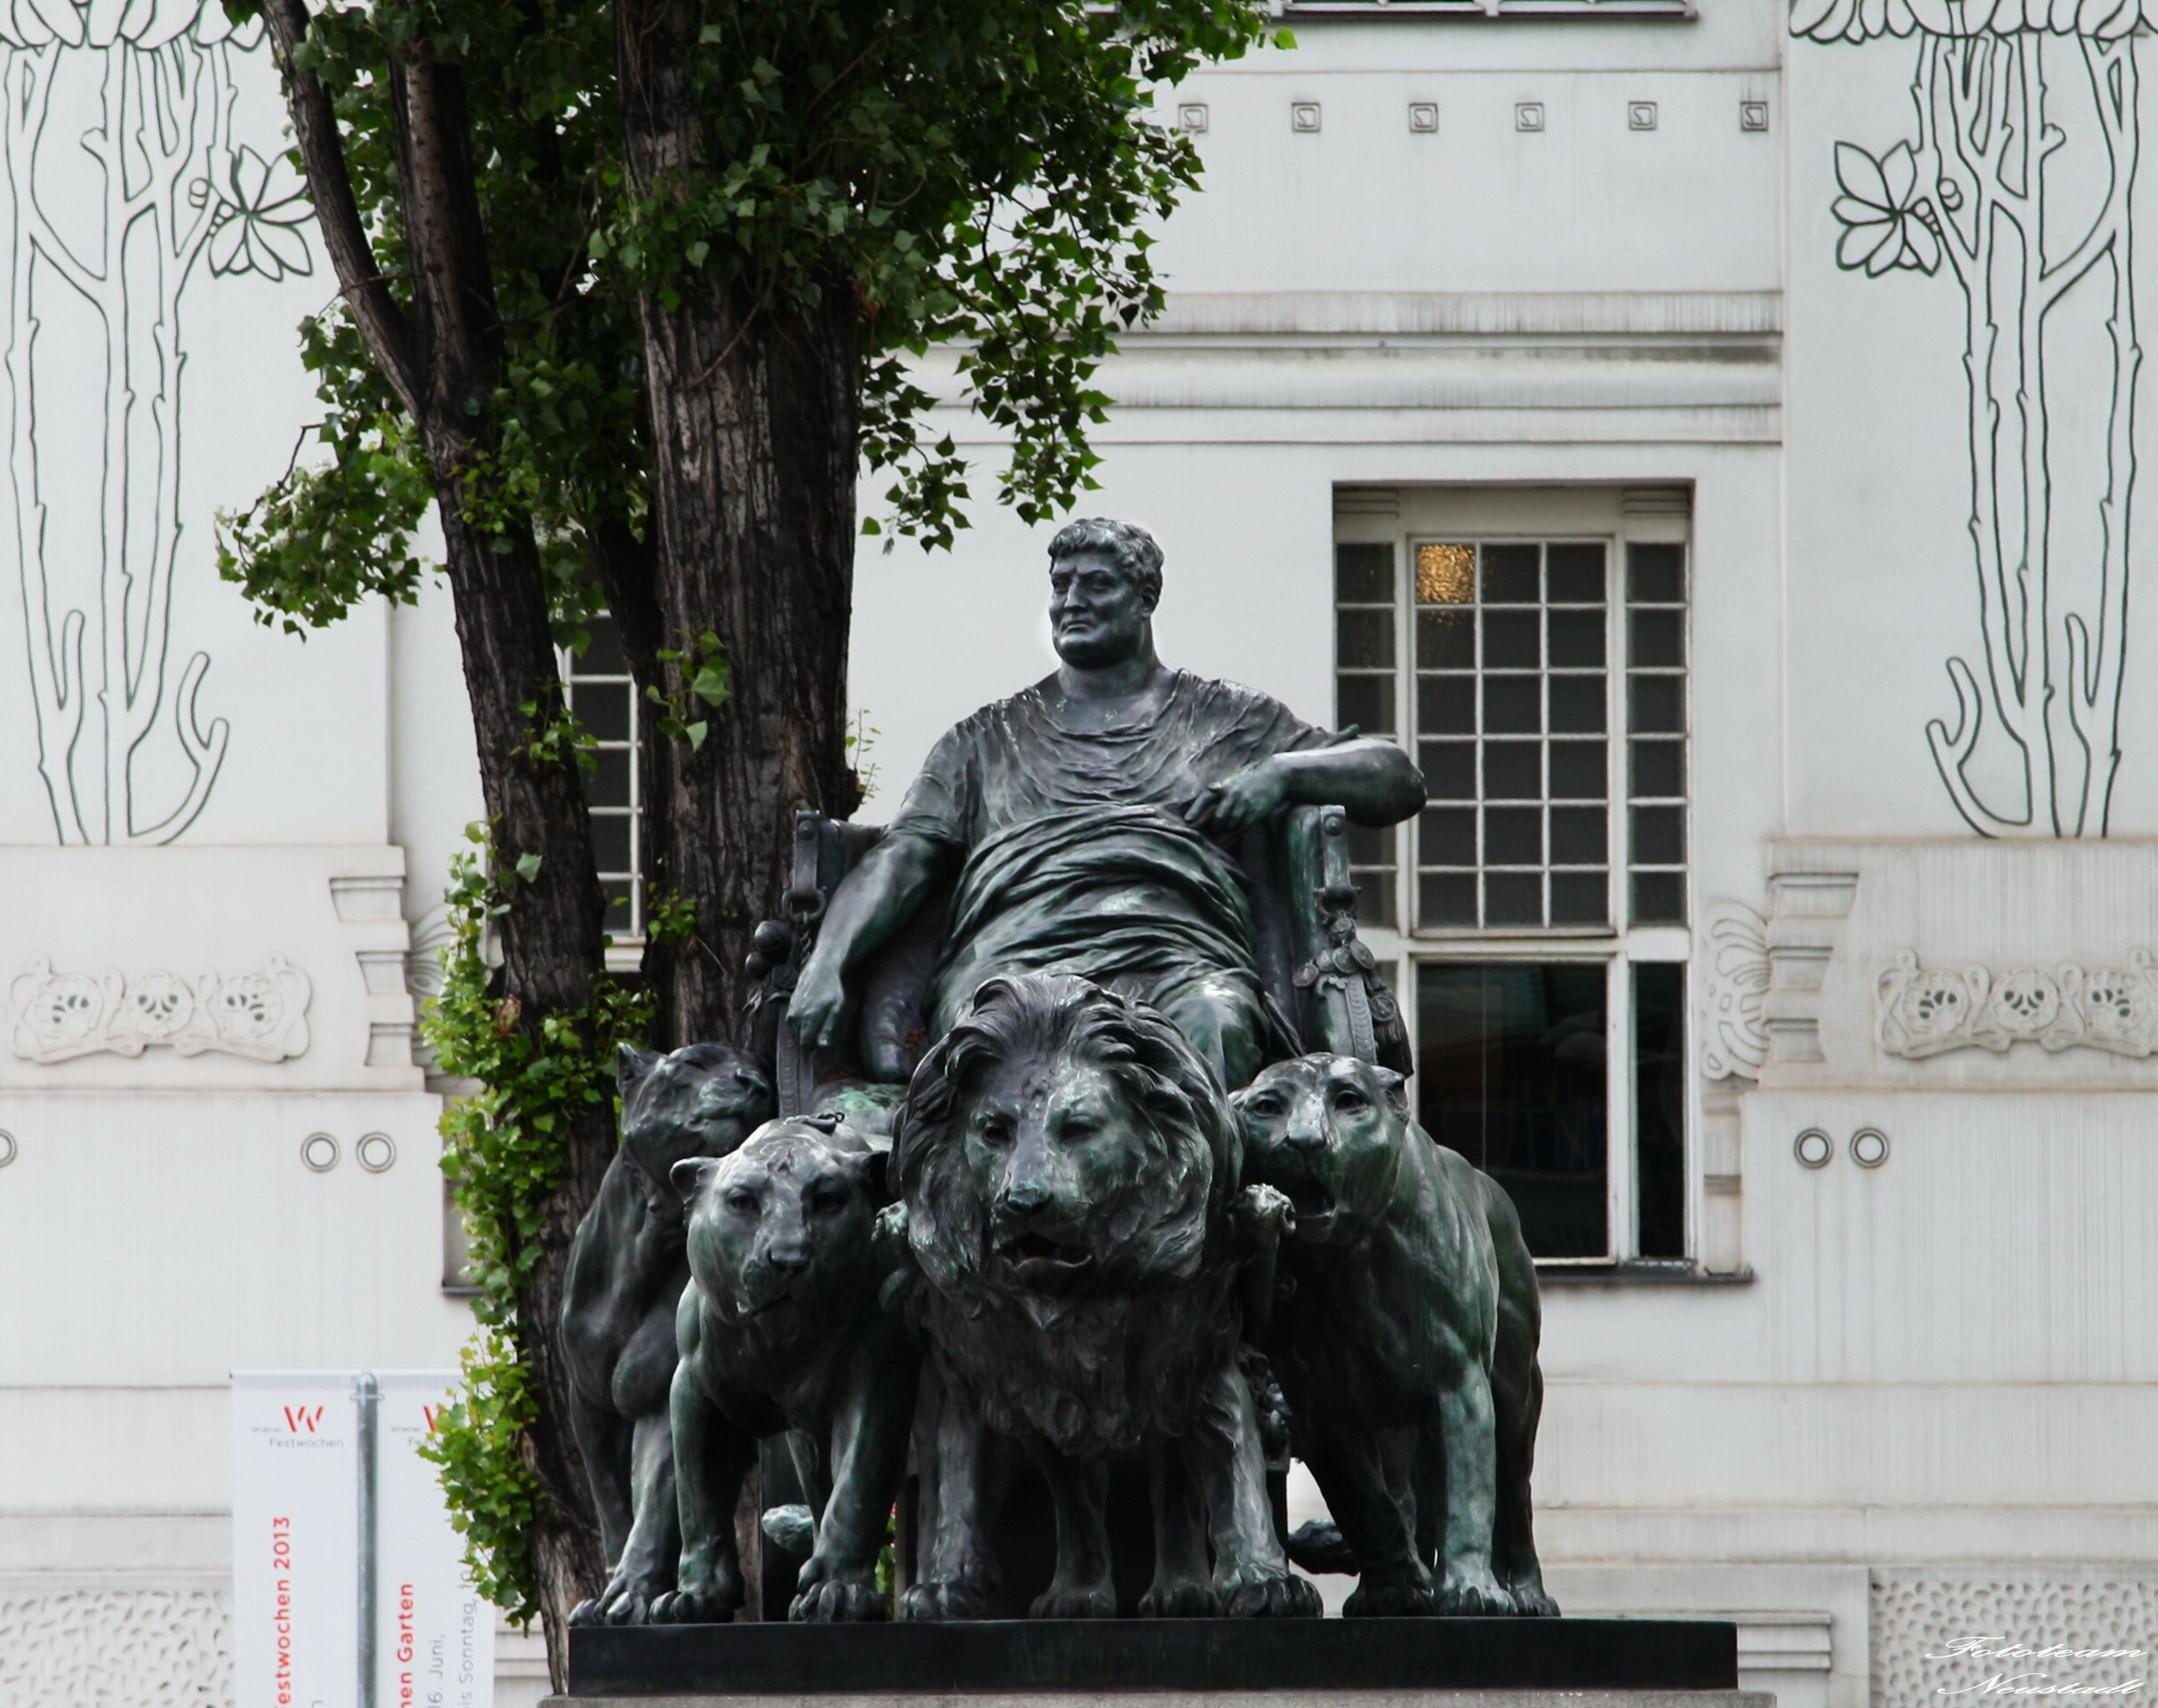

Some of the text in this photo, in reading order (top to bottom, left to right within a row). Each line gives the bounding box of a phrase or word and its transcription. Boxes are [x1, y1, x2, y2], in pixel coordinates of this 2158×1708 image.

[270, 1438, 344, 1448] Festwochen
[273, 1516, 291, 1708] estwochen 2013
[397, 1583, 414, 1663] Garten
